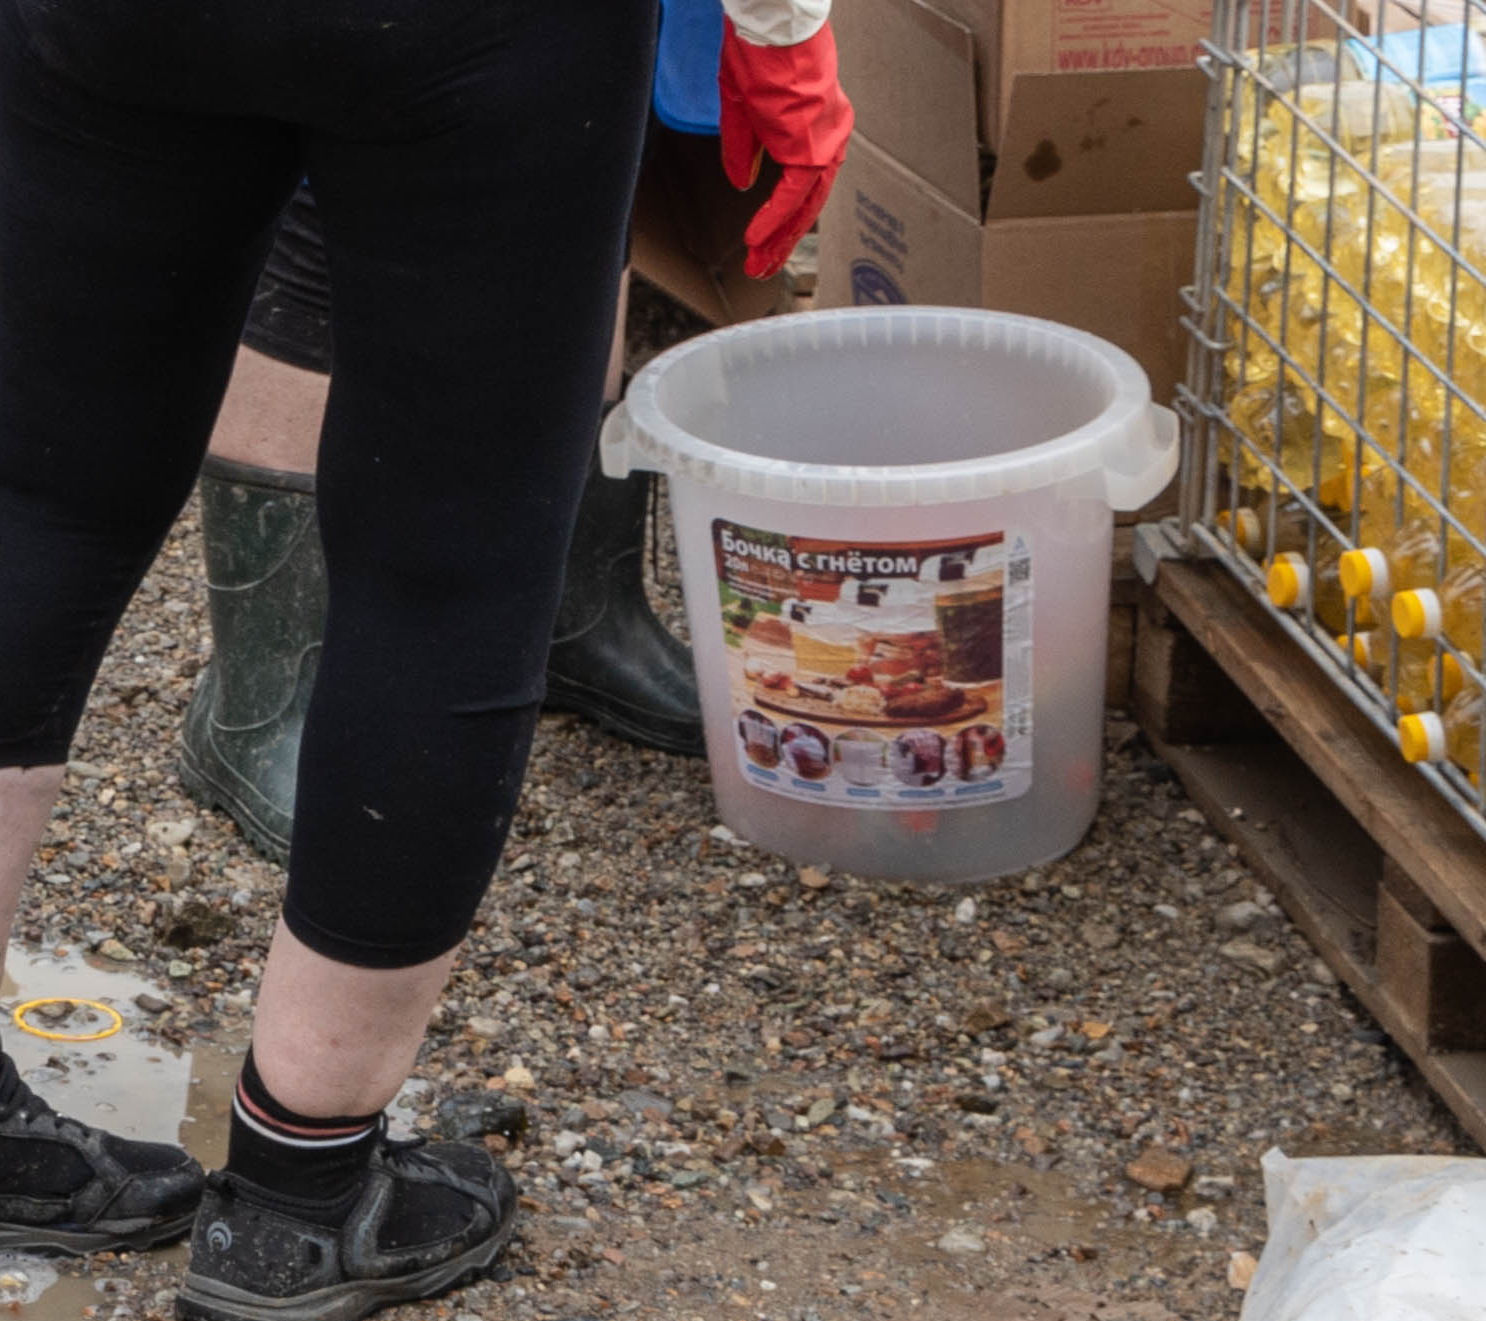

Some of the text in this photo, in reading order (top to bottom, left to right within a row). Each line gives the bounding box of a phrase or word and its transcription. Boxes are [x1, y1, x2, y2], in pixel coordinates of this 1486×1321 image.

[721, 531, 918, 574] Бочка с гнётом
